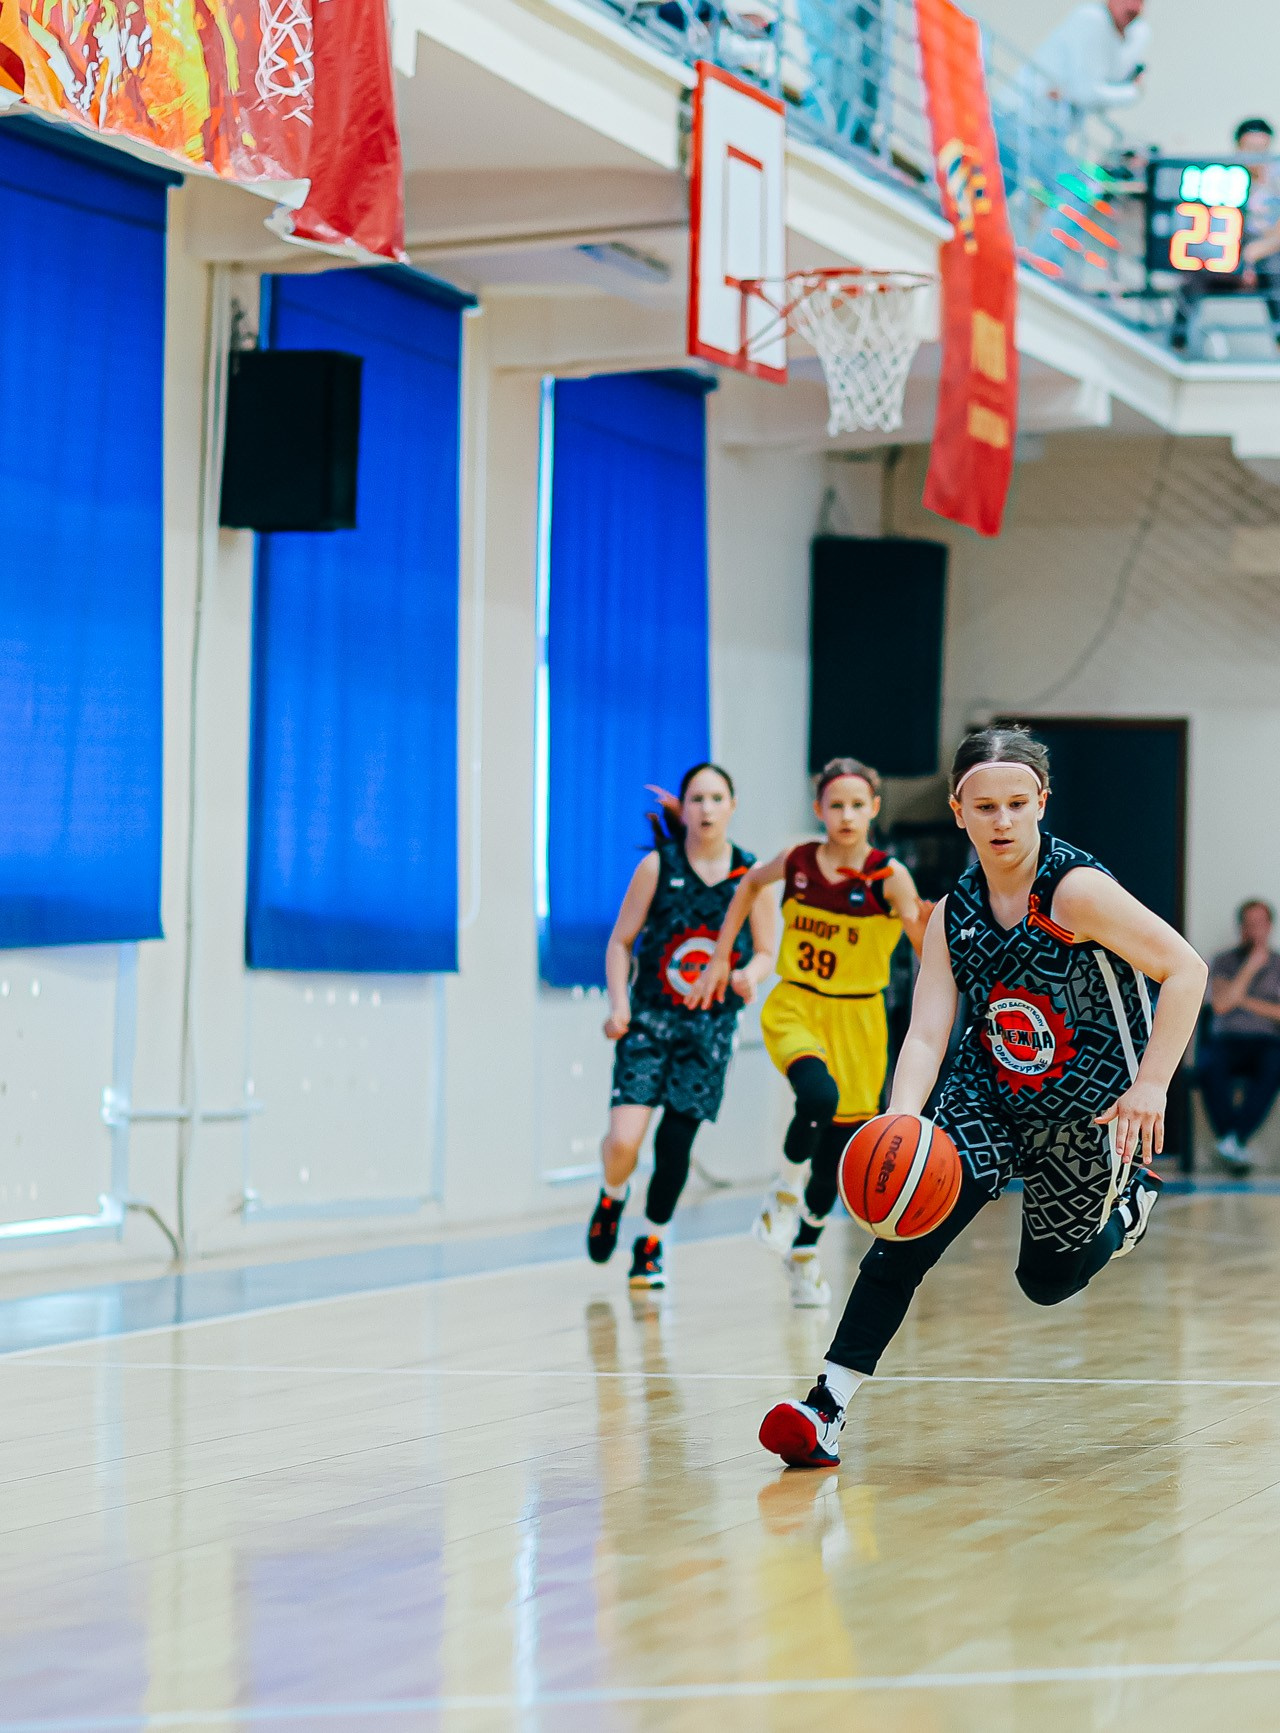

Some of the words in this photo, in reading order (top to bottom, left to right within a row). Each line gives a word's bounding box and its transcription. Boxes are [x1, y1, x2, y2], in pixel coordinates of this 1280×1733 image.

[1169, 202, 1244, 273] 23
[798, 941, 836, 981] 39
[848, 927, 859, 946] 5
[875, 1135, 903, 1194] molten
